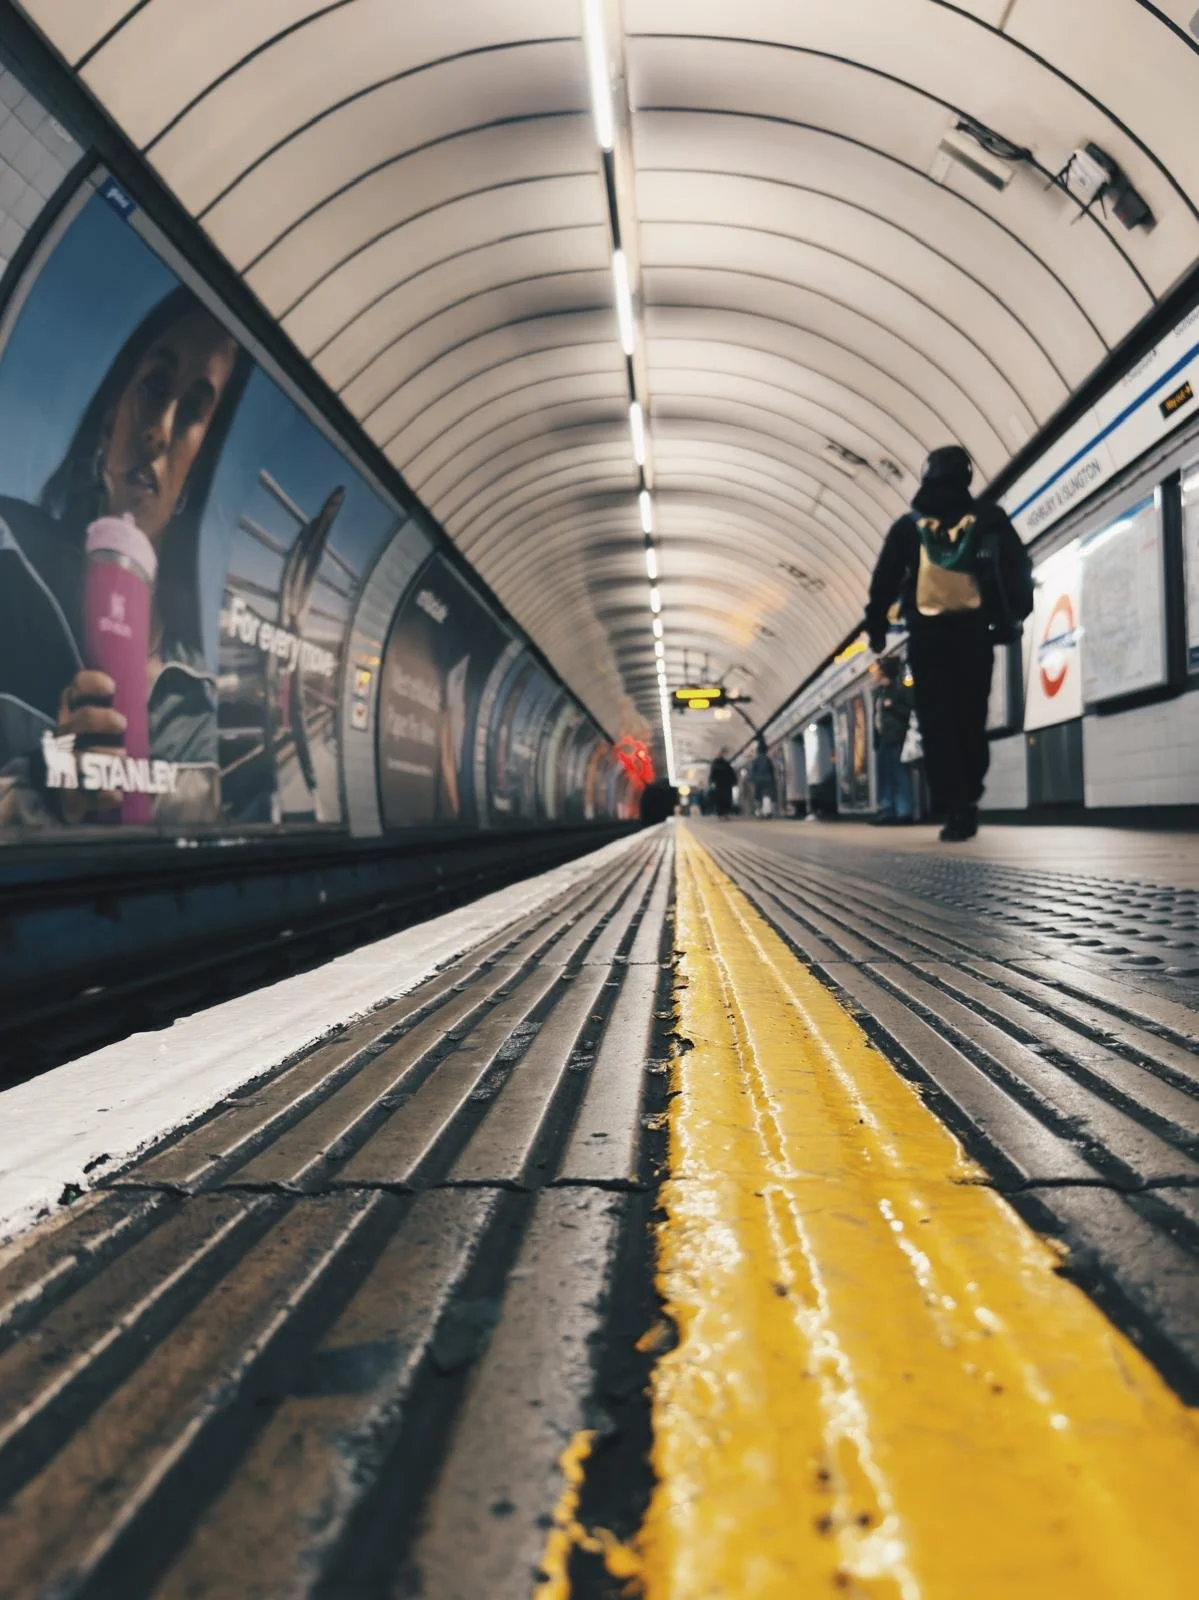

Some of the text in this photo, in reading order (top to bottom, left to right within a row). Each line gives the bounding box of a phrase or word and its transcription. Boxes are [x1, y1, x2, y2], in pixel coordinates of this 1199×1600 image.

[1061, 457, 1101, 501] ISLINGTON
[230, 597, 260, 646] For
[258, 622, 300, 672] every
[81, 752, 177, 793] STANLEY
